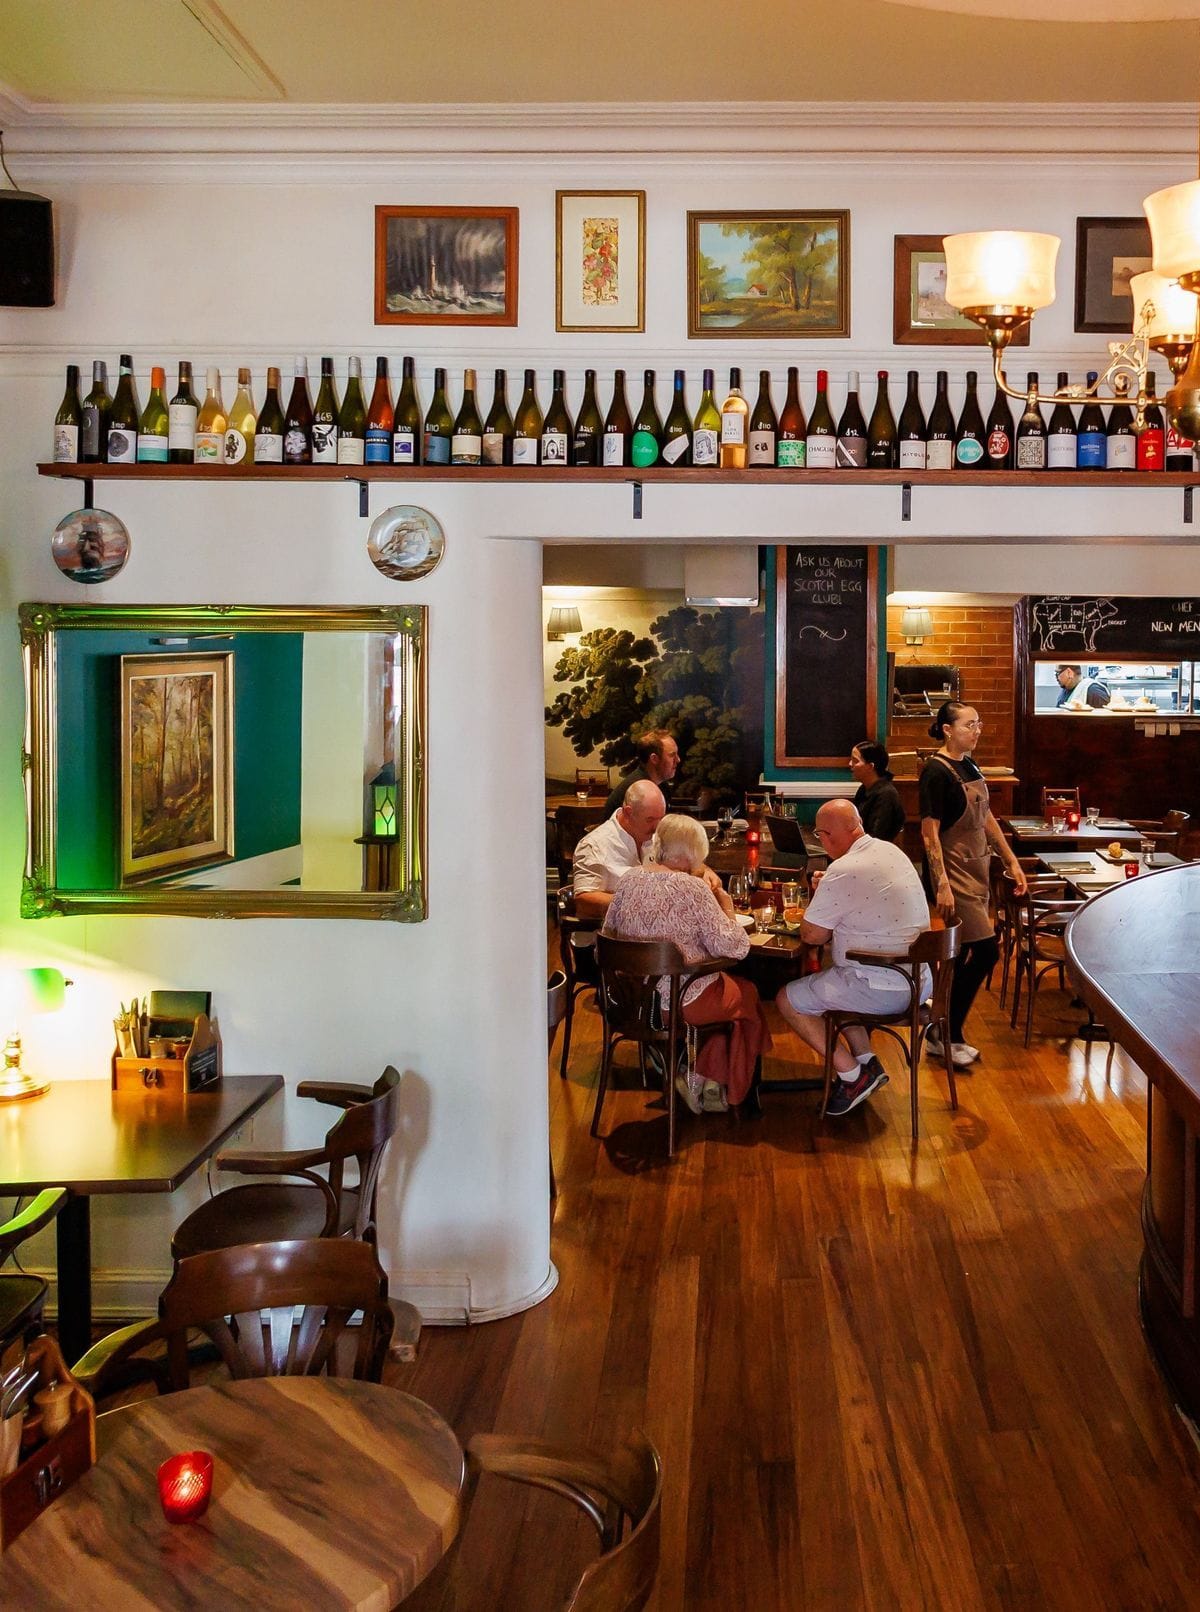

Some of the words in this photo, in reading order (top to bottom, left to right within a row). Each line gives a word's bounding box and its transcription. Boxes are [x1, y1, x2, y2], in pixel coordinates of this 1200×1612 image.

[315, 412, 333, 422] $65
[795, 552, 815, 568] ASK
[819, 557, 830, 567] US
[834, 557, 864, 569] ABOUT
[814, 568, 837, 578] OUR
[794, 578, 834, 592] SCOTCH
[841, 580, 862, 593] EGG
[1151, 620, 1173, 633] NEW
